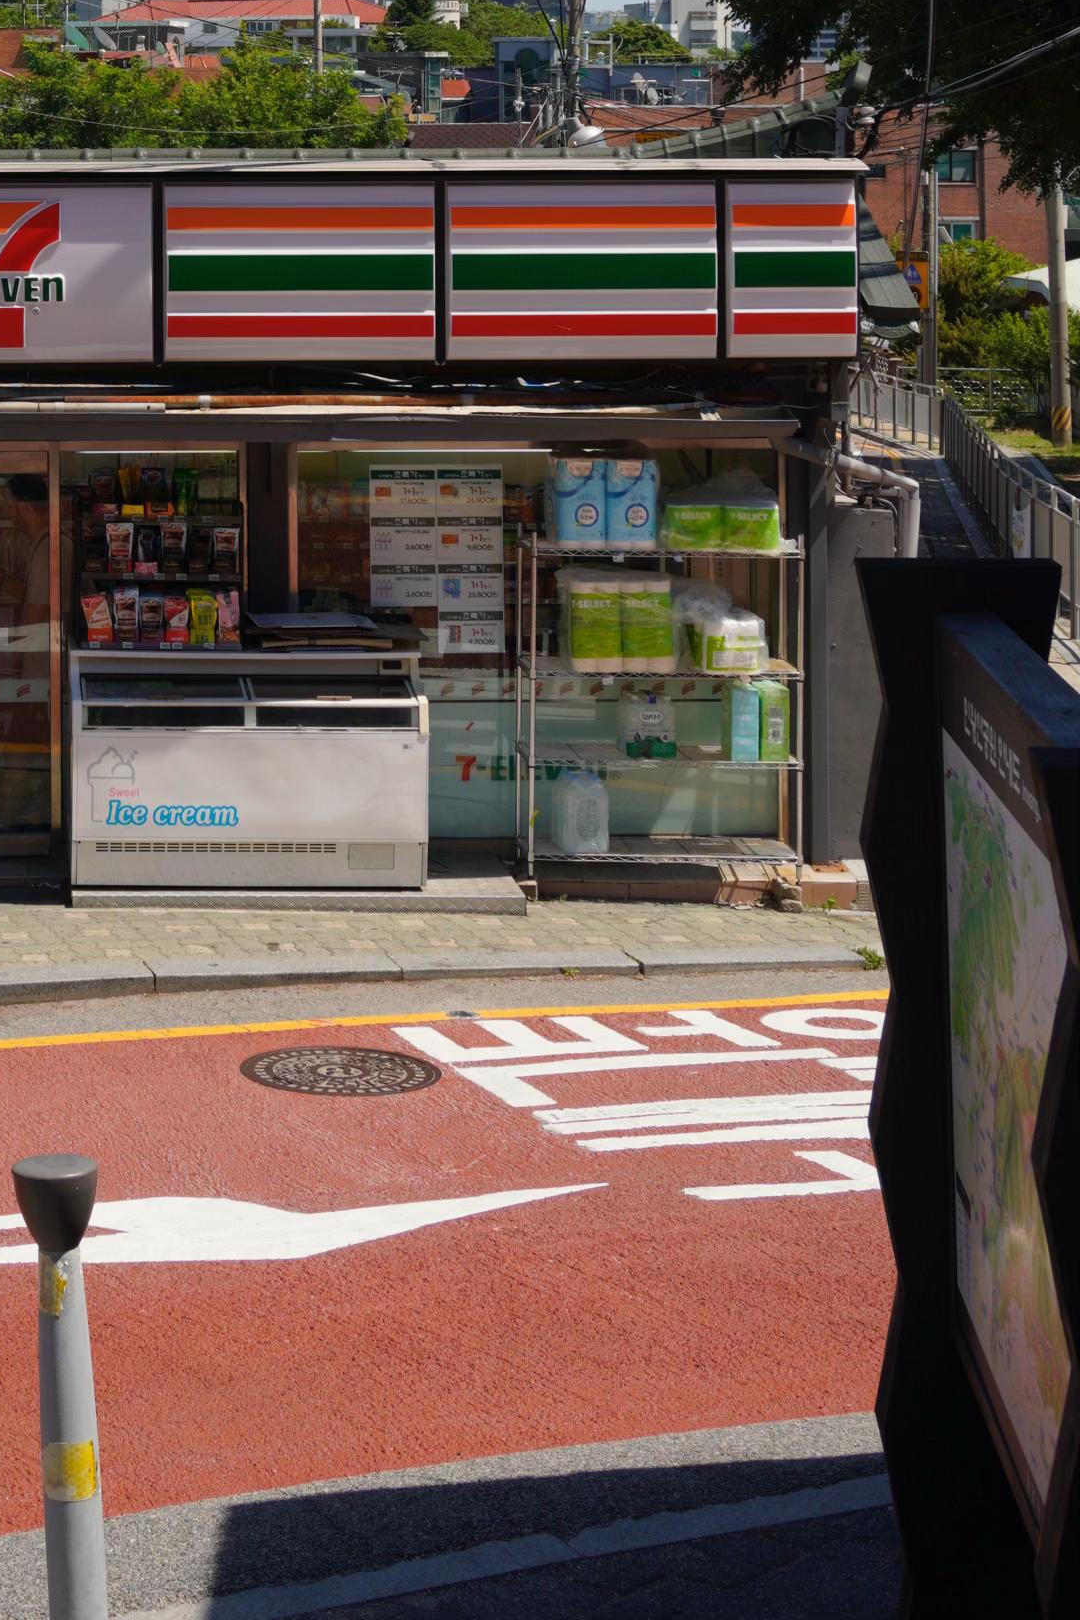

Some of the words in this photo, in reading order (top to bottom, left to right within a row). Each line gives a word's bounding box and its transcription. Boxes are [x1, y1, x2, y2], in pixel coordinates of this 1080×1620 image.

[108, 787, 140, 798] Sweet
[105, 799, 149, 826] Ice
[152, 804, 240, 827] cream
